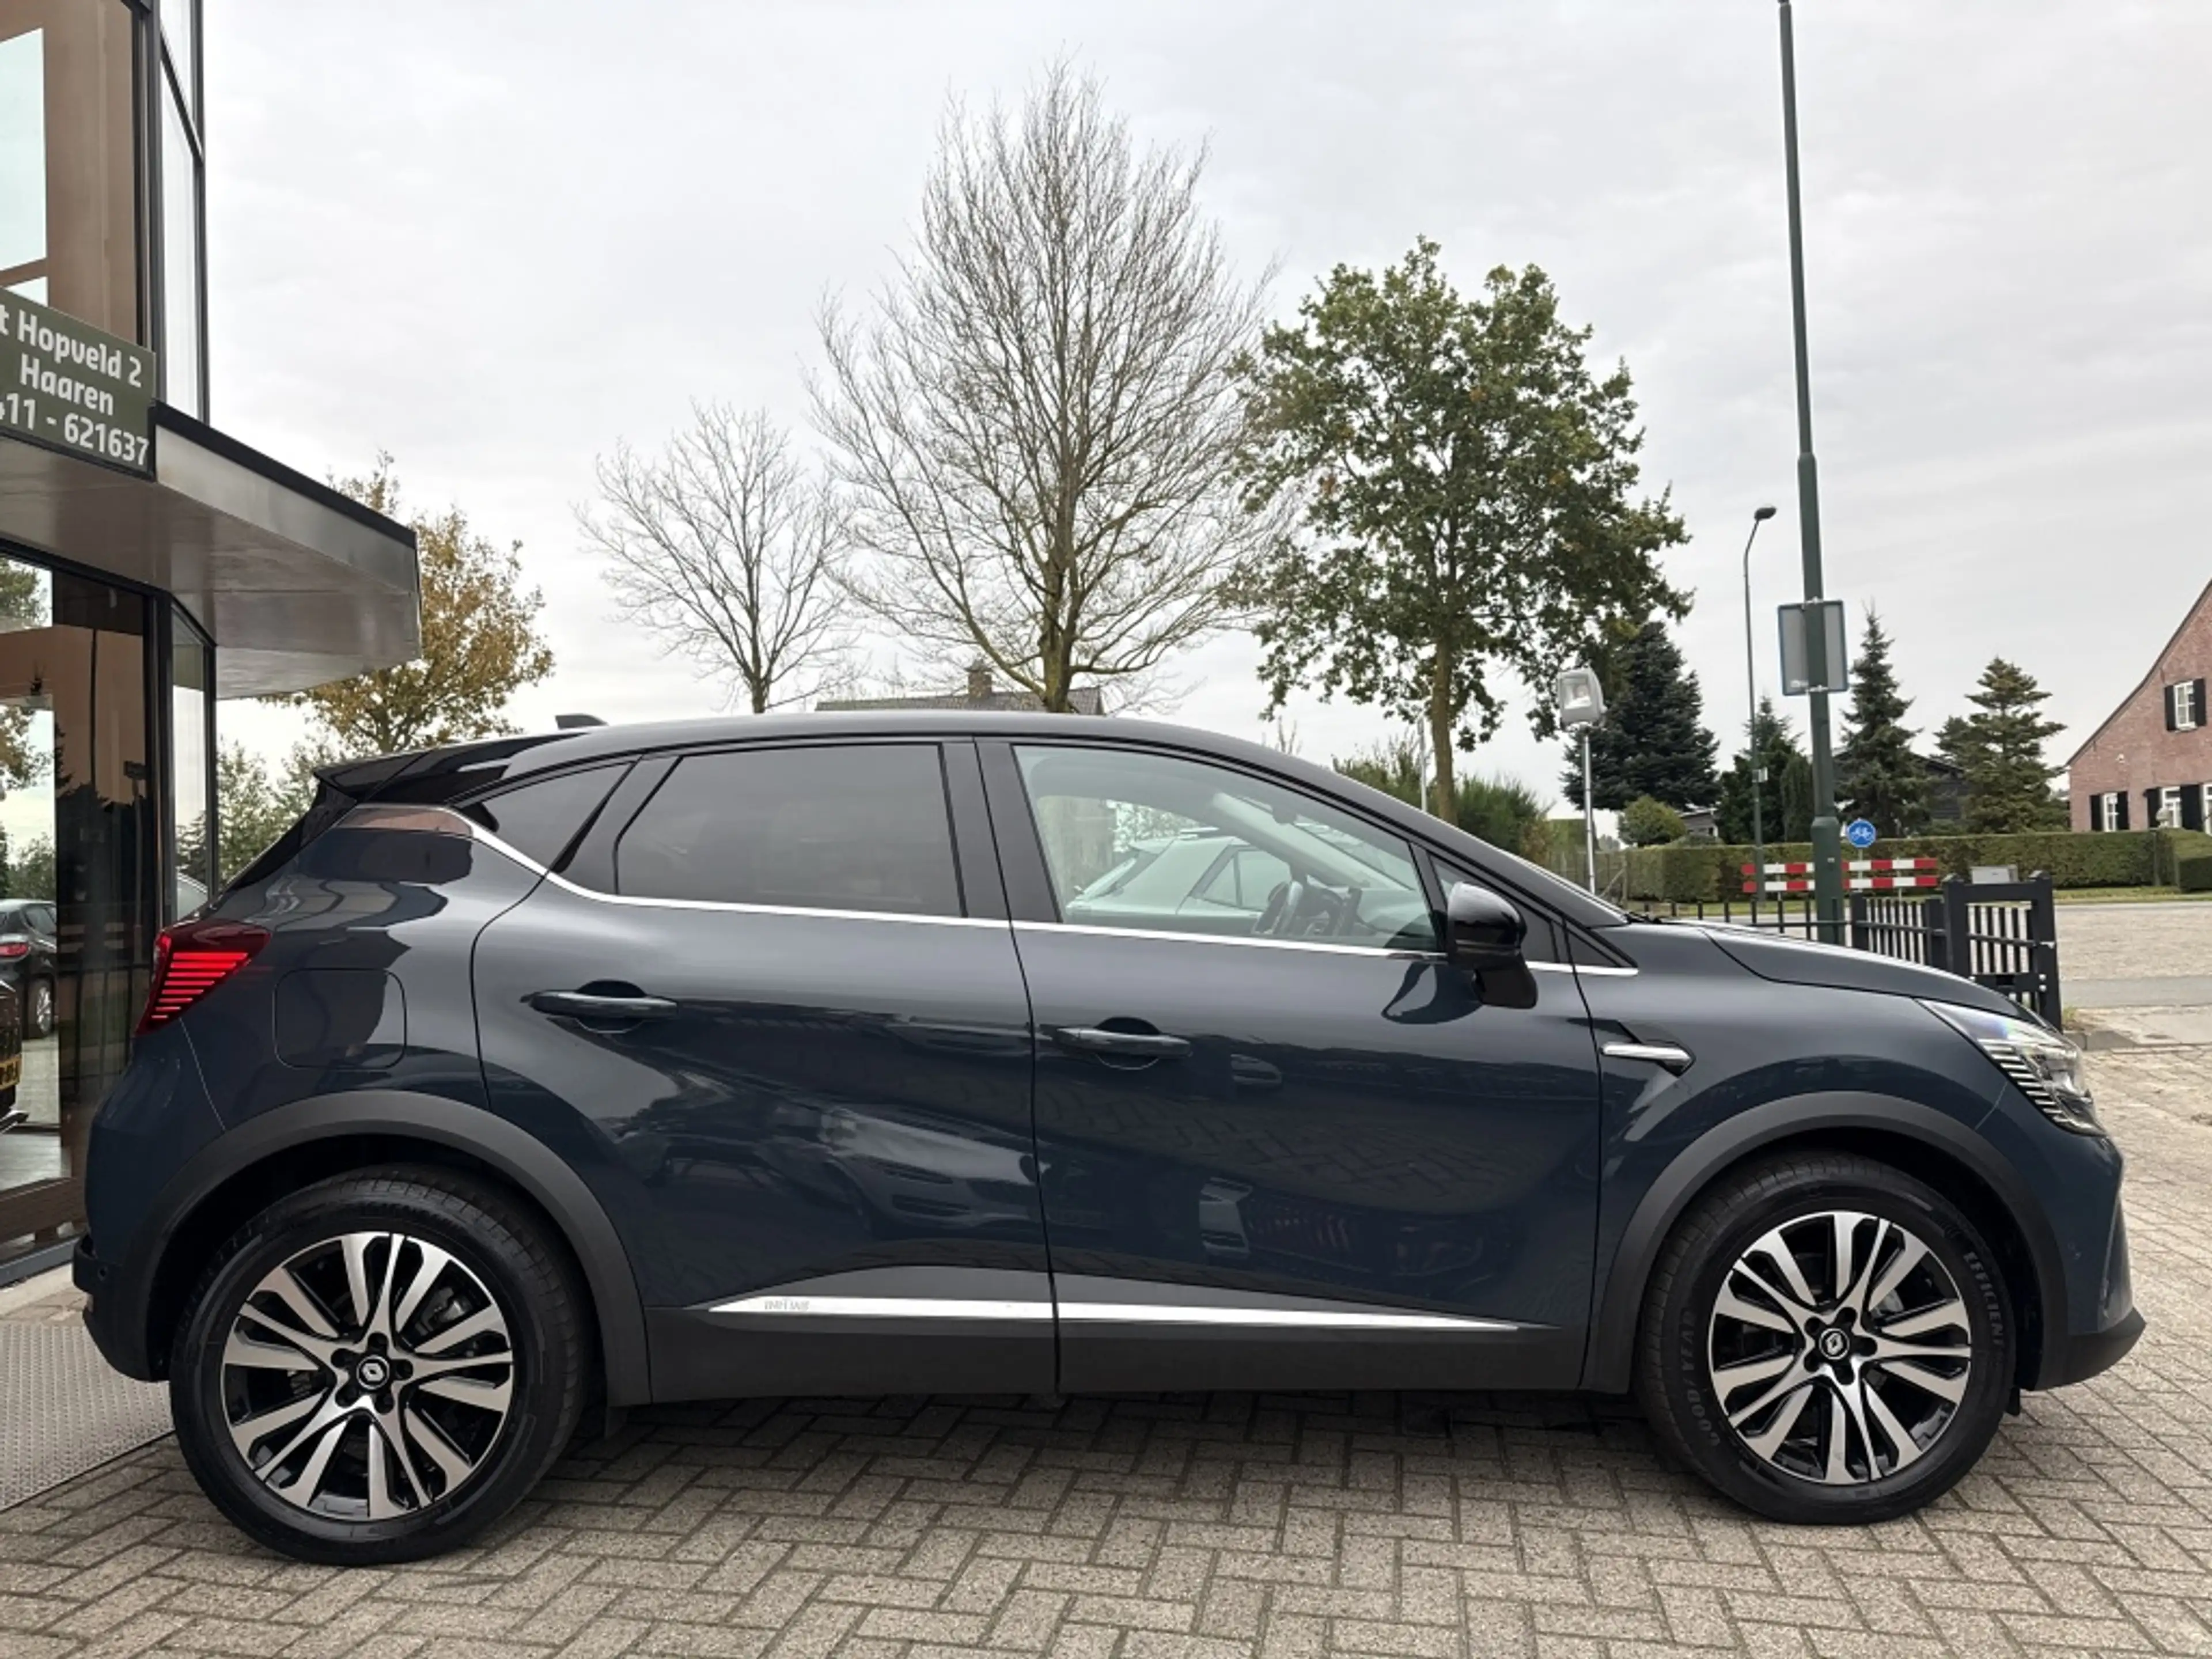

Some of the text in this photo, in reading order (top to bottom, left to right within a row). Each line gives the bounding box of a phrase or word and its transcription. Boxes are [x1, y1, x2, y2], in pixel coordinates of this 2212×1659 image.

[18, 309, 122, 380] Hopveld
[128, 356, 142, 388] 2
[20, 353, 113, 416] Haaren
[65, 414, 150, 465] 621637
